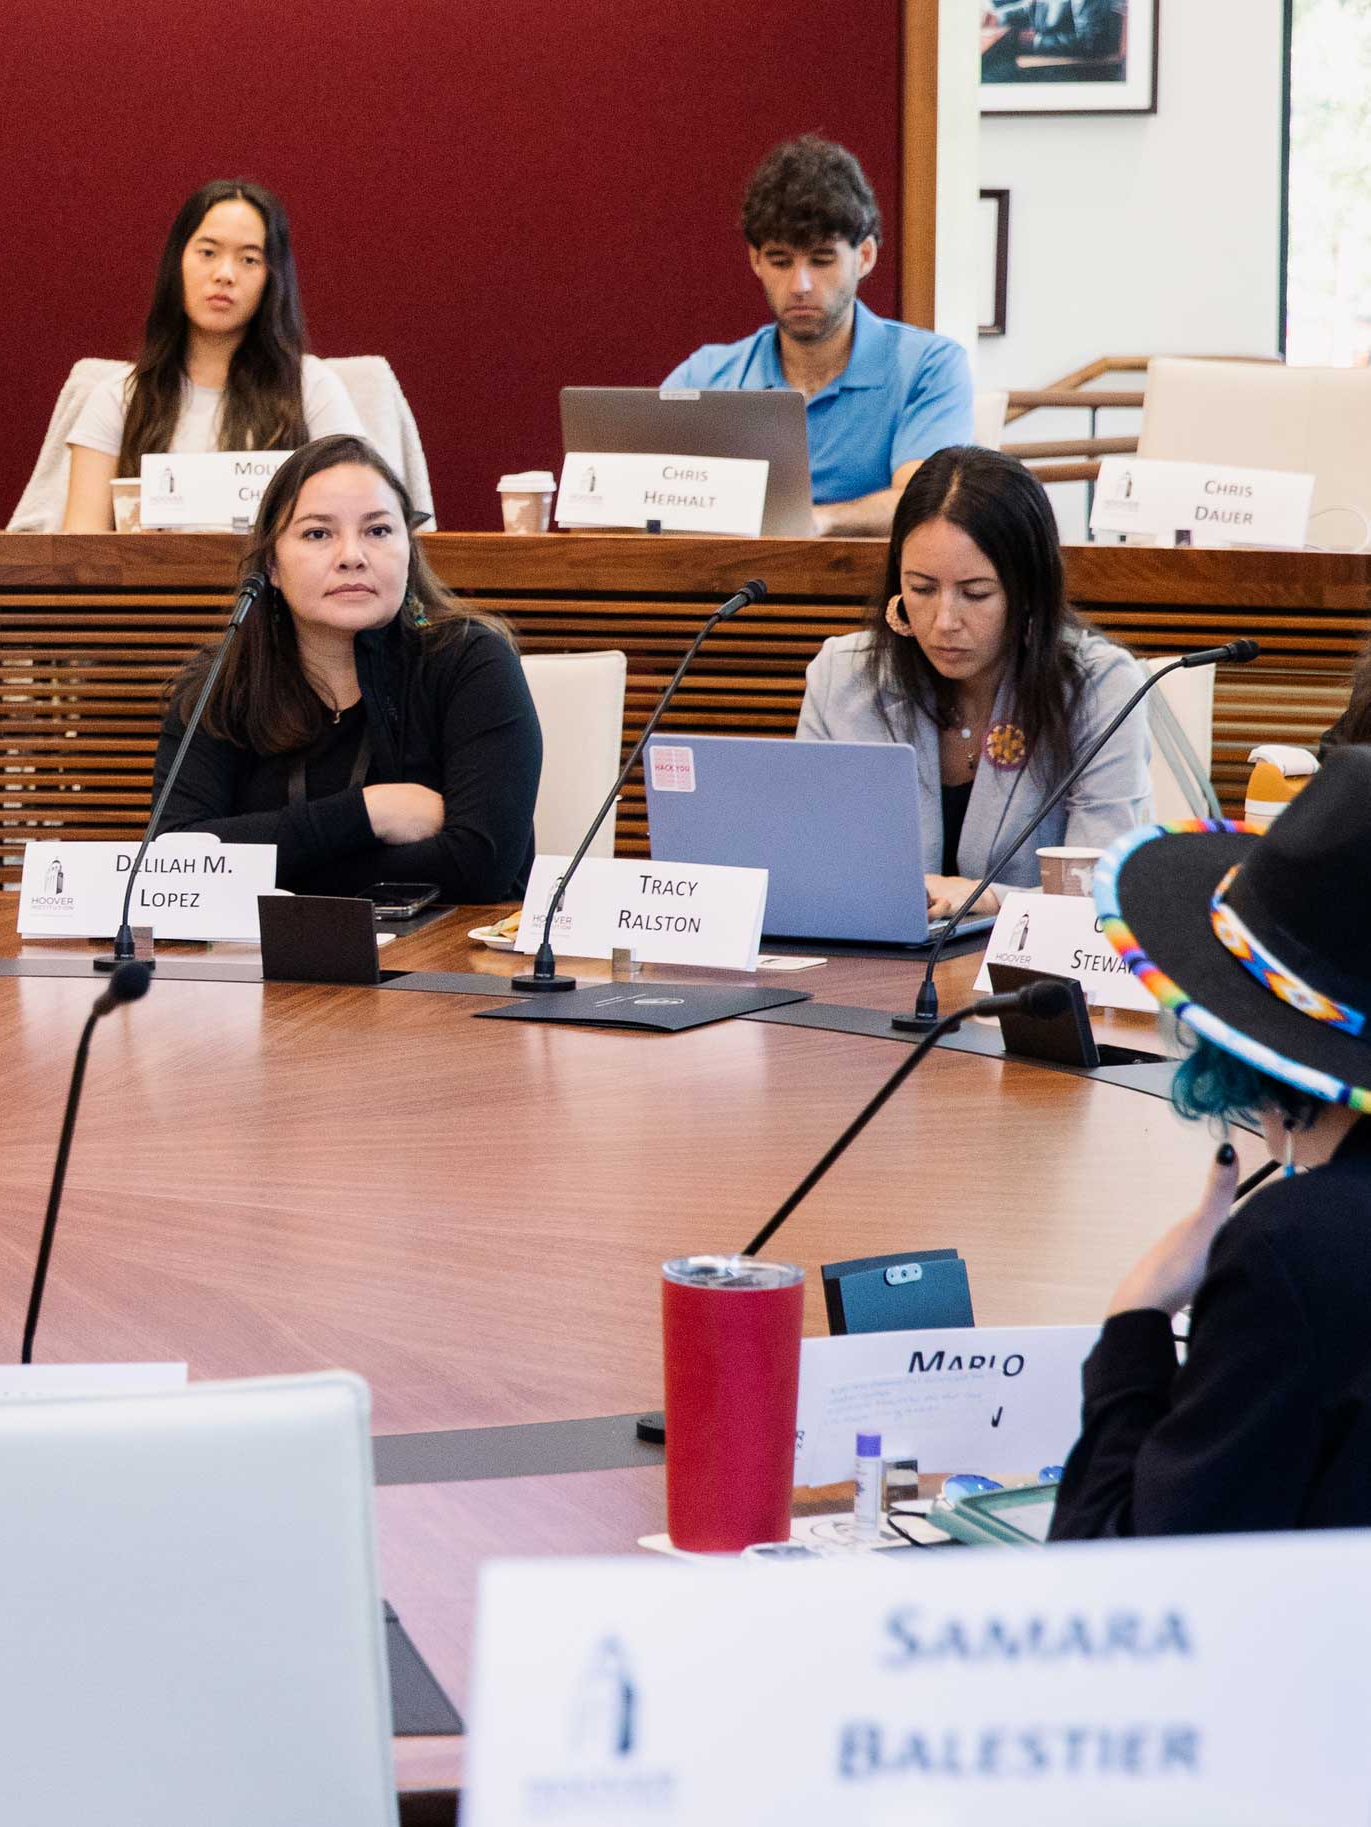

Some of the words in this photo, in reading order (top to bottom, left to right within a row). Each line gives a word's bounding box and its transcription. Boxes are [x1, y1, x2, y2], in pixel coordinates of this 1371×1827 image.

[662, 466, 708, 482] CHRIS
[238, 487, 261, 501] CH
[1204, 480, 1253, 498] CHRIS
[1195, 506, 1253, 525] DAUER
[116, 854, 196, 874] DLILAH
[203, 855, 233, 874] M.
[640, 875, 698, 897] TRACY
[31, 896, 74, 905] HOOVER
[141, 889, 200, 908] LOPEZ
[533, 914, 572, 923] HOVER
[618, 910, 701, 933] RALSTON
[996, 953, 1032, 964] HOOVER
[883, 1608, 1196, 1668] SAMARA
[838, 1722, 1202, 1782] BALESTIER
